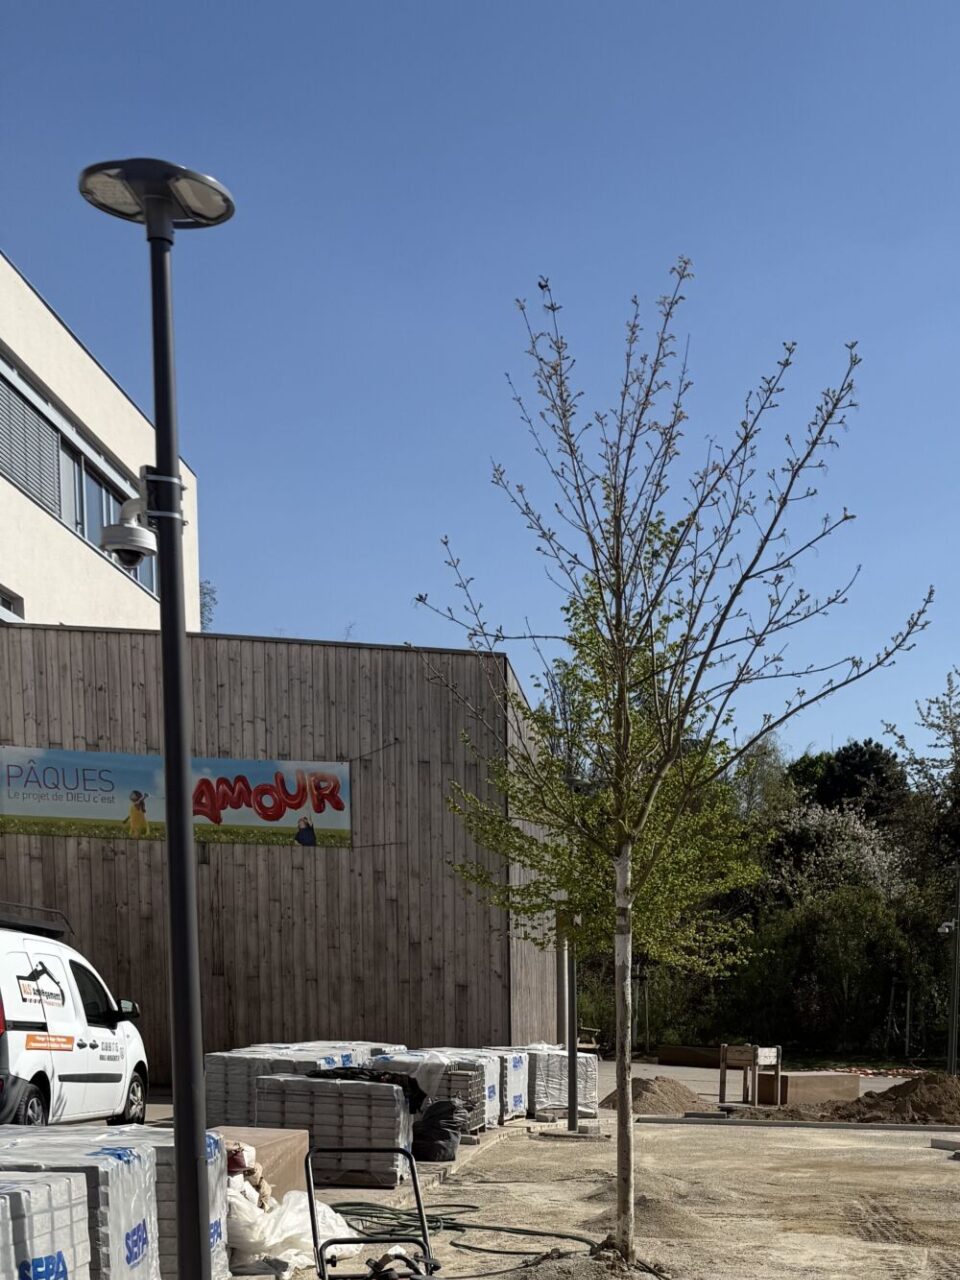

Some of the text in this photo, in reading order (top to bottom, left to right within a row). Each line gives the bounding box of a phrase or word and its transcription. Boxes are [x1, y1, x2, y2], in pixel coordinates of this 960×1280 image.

[6, 759, 115, 792] PÂQUES
[7, 789, 19, 799] Le
[22, 791, 50, 803] projet
[52, 792, 63, 802] de
[66, 792, 91, 803] DIEU
[192, 769, 345, 824] AMOUR
[125, 1218, 149, 1265] SEPA
[210, 1218, 222, 1248] EPA
